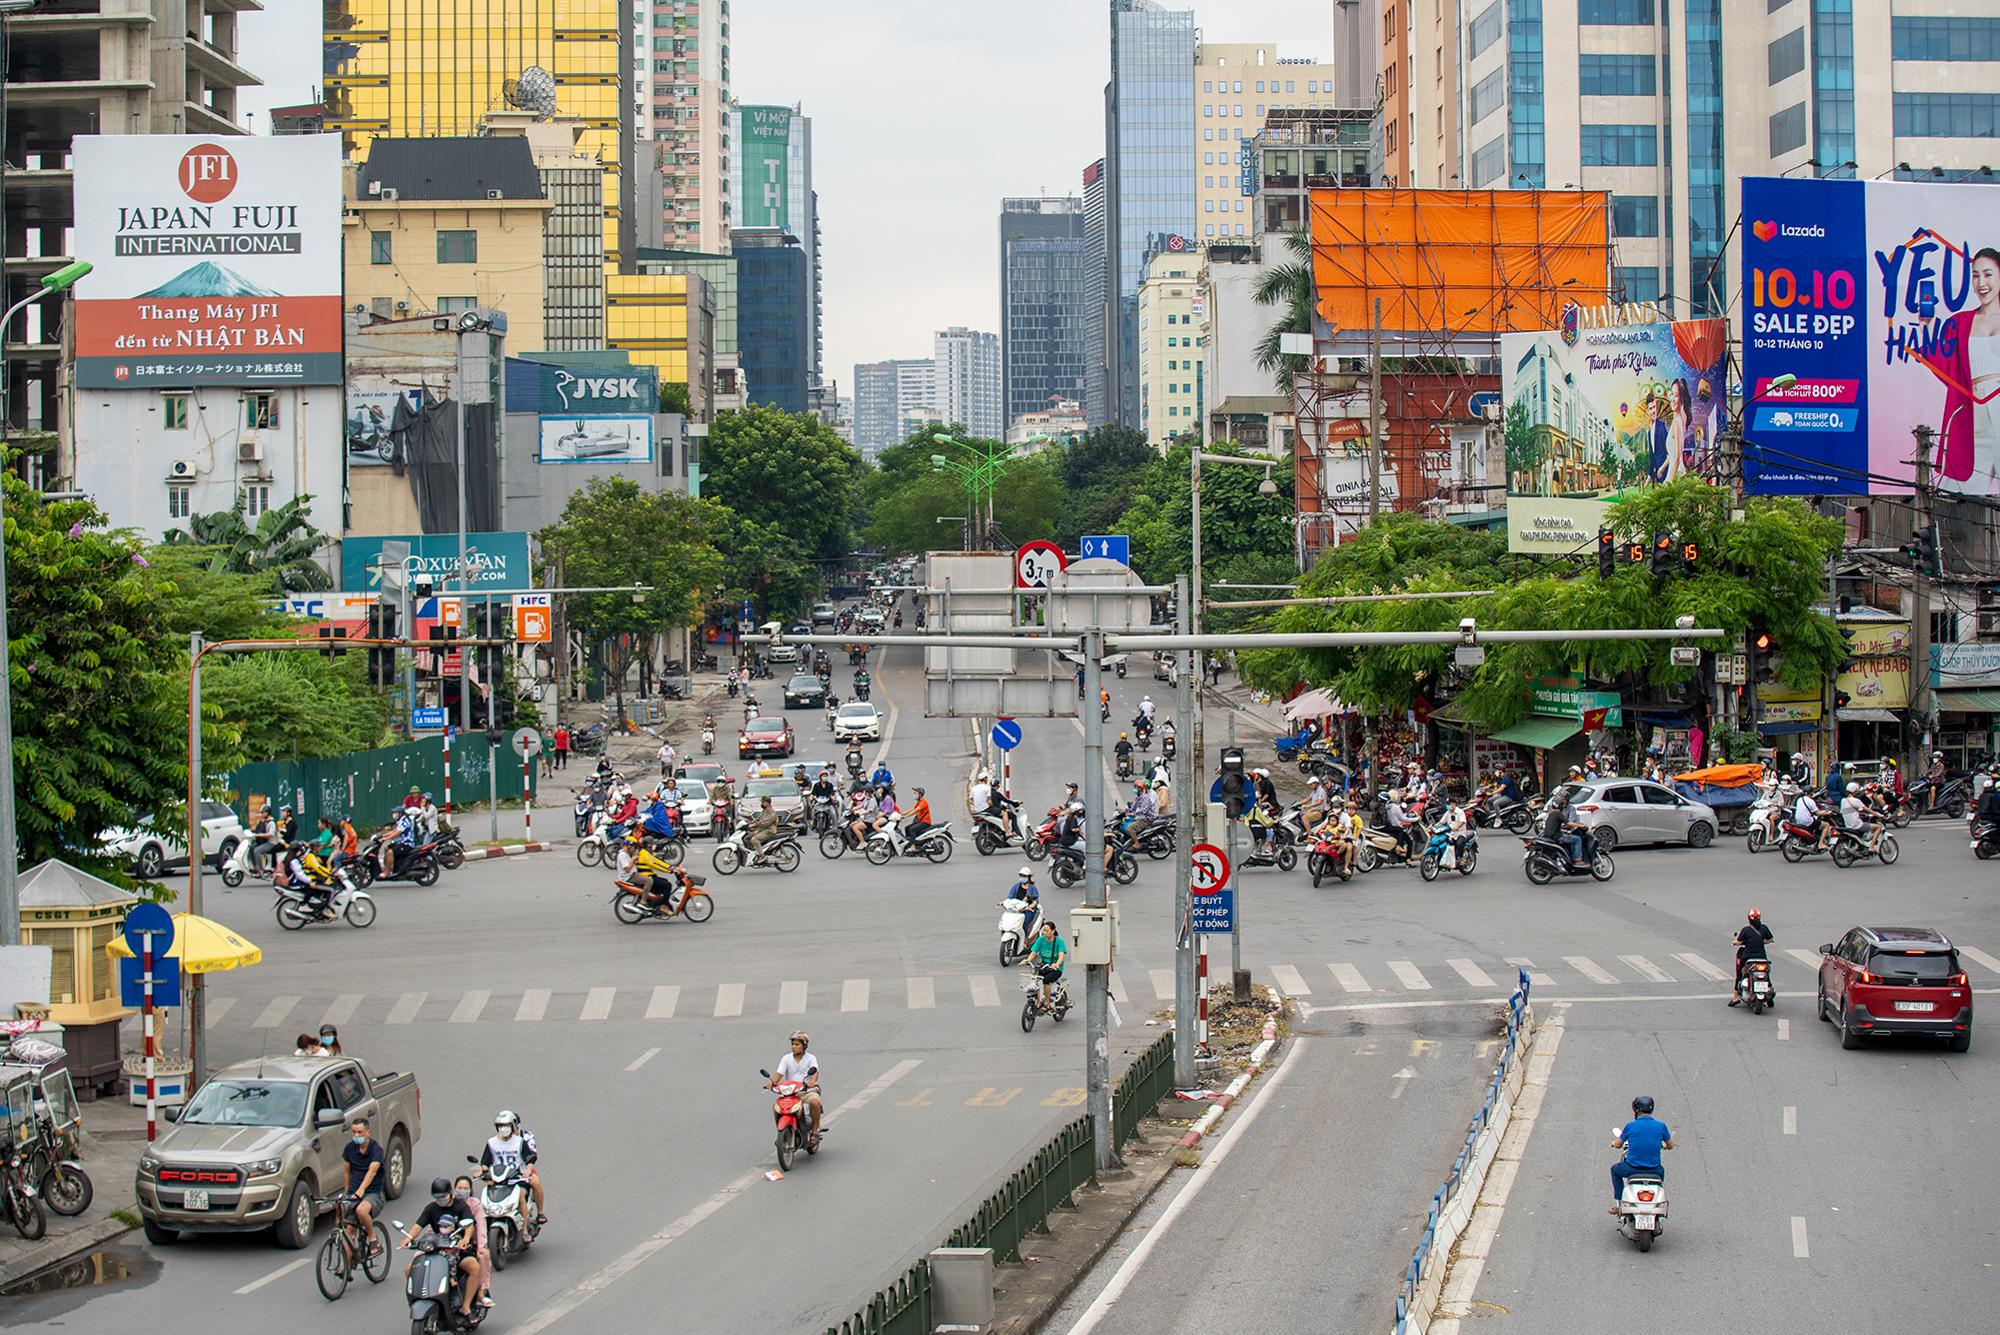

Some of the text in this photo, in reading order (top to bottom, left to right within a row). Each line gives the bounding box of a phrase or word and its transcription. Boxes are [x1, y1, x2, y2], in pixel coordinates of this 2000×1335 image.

[186, 154, 231, 193] JFI
[1242, 149, 1251, 195] HOTEL
[118, 205, 298, 233] JAPAN FUJI
[1781, 223, 1825, 238] Lazada
[122, 235, 295, 255] INTERNATIONAL
[1874, 227, 1970, 318] YÊU
[138, 303, 279, 323] Thang Máy JFI
[1753, 312, 1855, 340] SALE ĐẸP
[114, 324, 305, 350] đến từ NHẬT BẢN
[1754, 337, 1824, 350] 10-12 THÁNG 10
[135, 363, 304, 376] 日本富士インターナショナル株式会社
[1585, 353, 1611, 374] Thành
[1612, 353, 1628, 374] phố
[1642, 352, 1658, 368] hoa
[116, 367, 129, 379] JFI
[572, 378, 640, 399] JYSK
[1794, 412, 1829, 420] FREESHIP
[1336, 481, 1360, 493] VINID
[1631, 545, 1643, 561] 15
[1684, 544, 1697, 560] 15
[520, 597, 546, 606] HFC
[1870, 656, 1908, 678] KEBAB
[1201, 894, 1223, 905] BUÝT
[35, 911, 71, 920] CSGT
[1206, 906, 1229, 917] PHÉP
[1205, 918, 1230, 930] ĐỘNG
[160, 1171, 237, 1182] FORD
